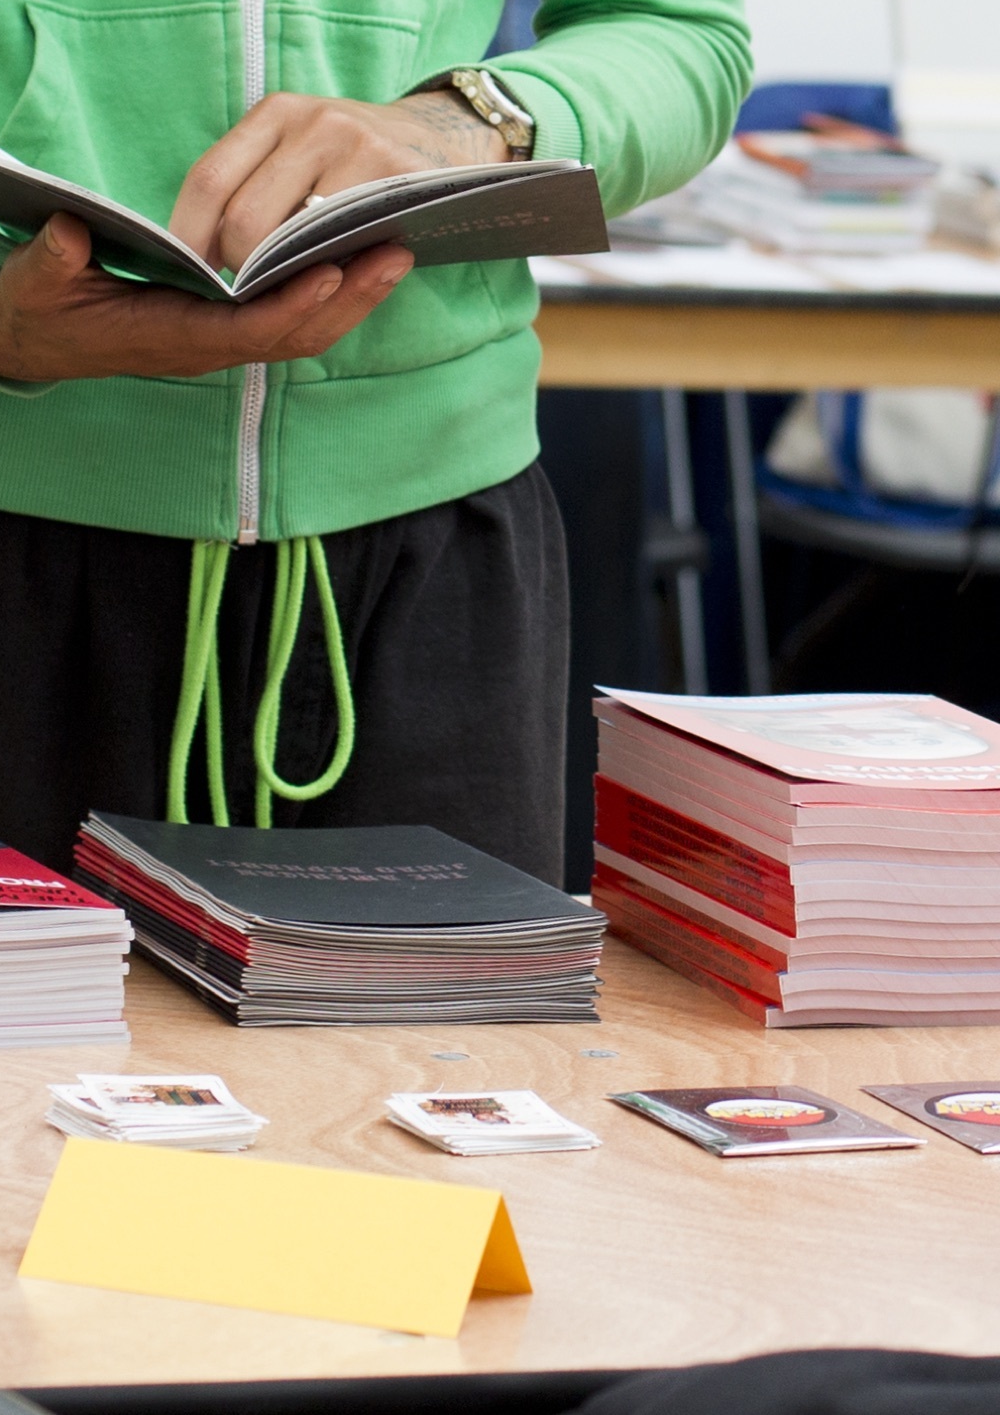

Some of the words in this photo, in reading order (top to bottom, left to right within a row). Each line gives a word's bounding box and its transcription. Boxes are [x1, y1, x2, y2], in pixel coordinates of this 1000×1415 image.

[374, 862, 467, 874] JIHAD
[235, 868, 400, 881] AMERICAN
[408, 870, 468, 881] THE
[26, 894, 93, 904] THE
